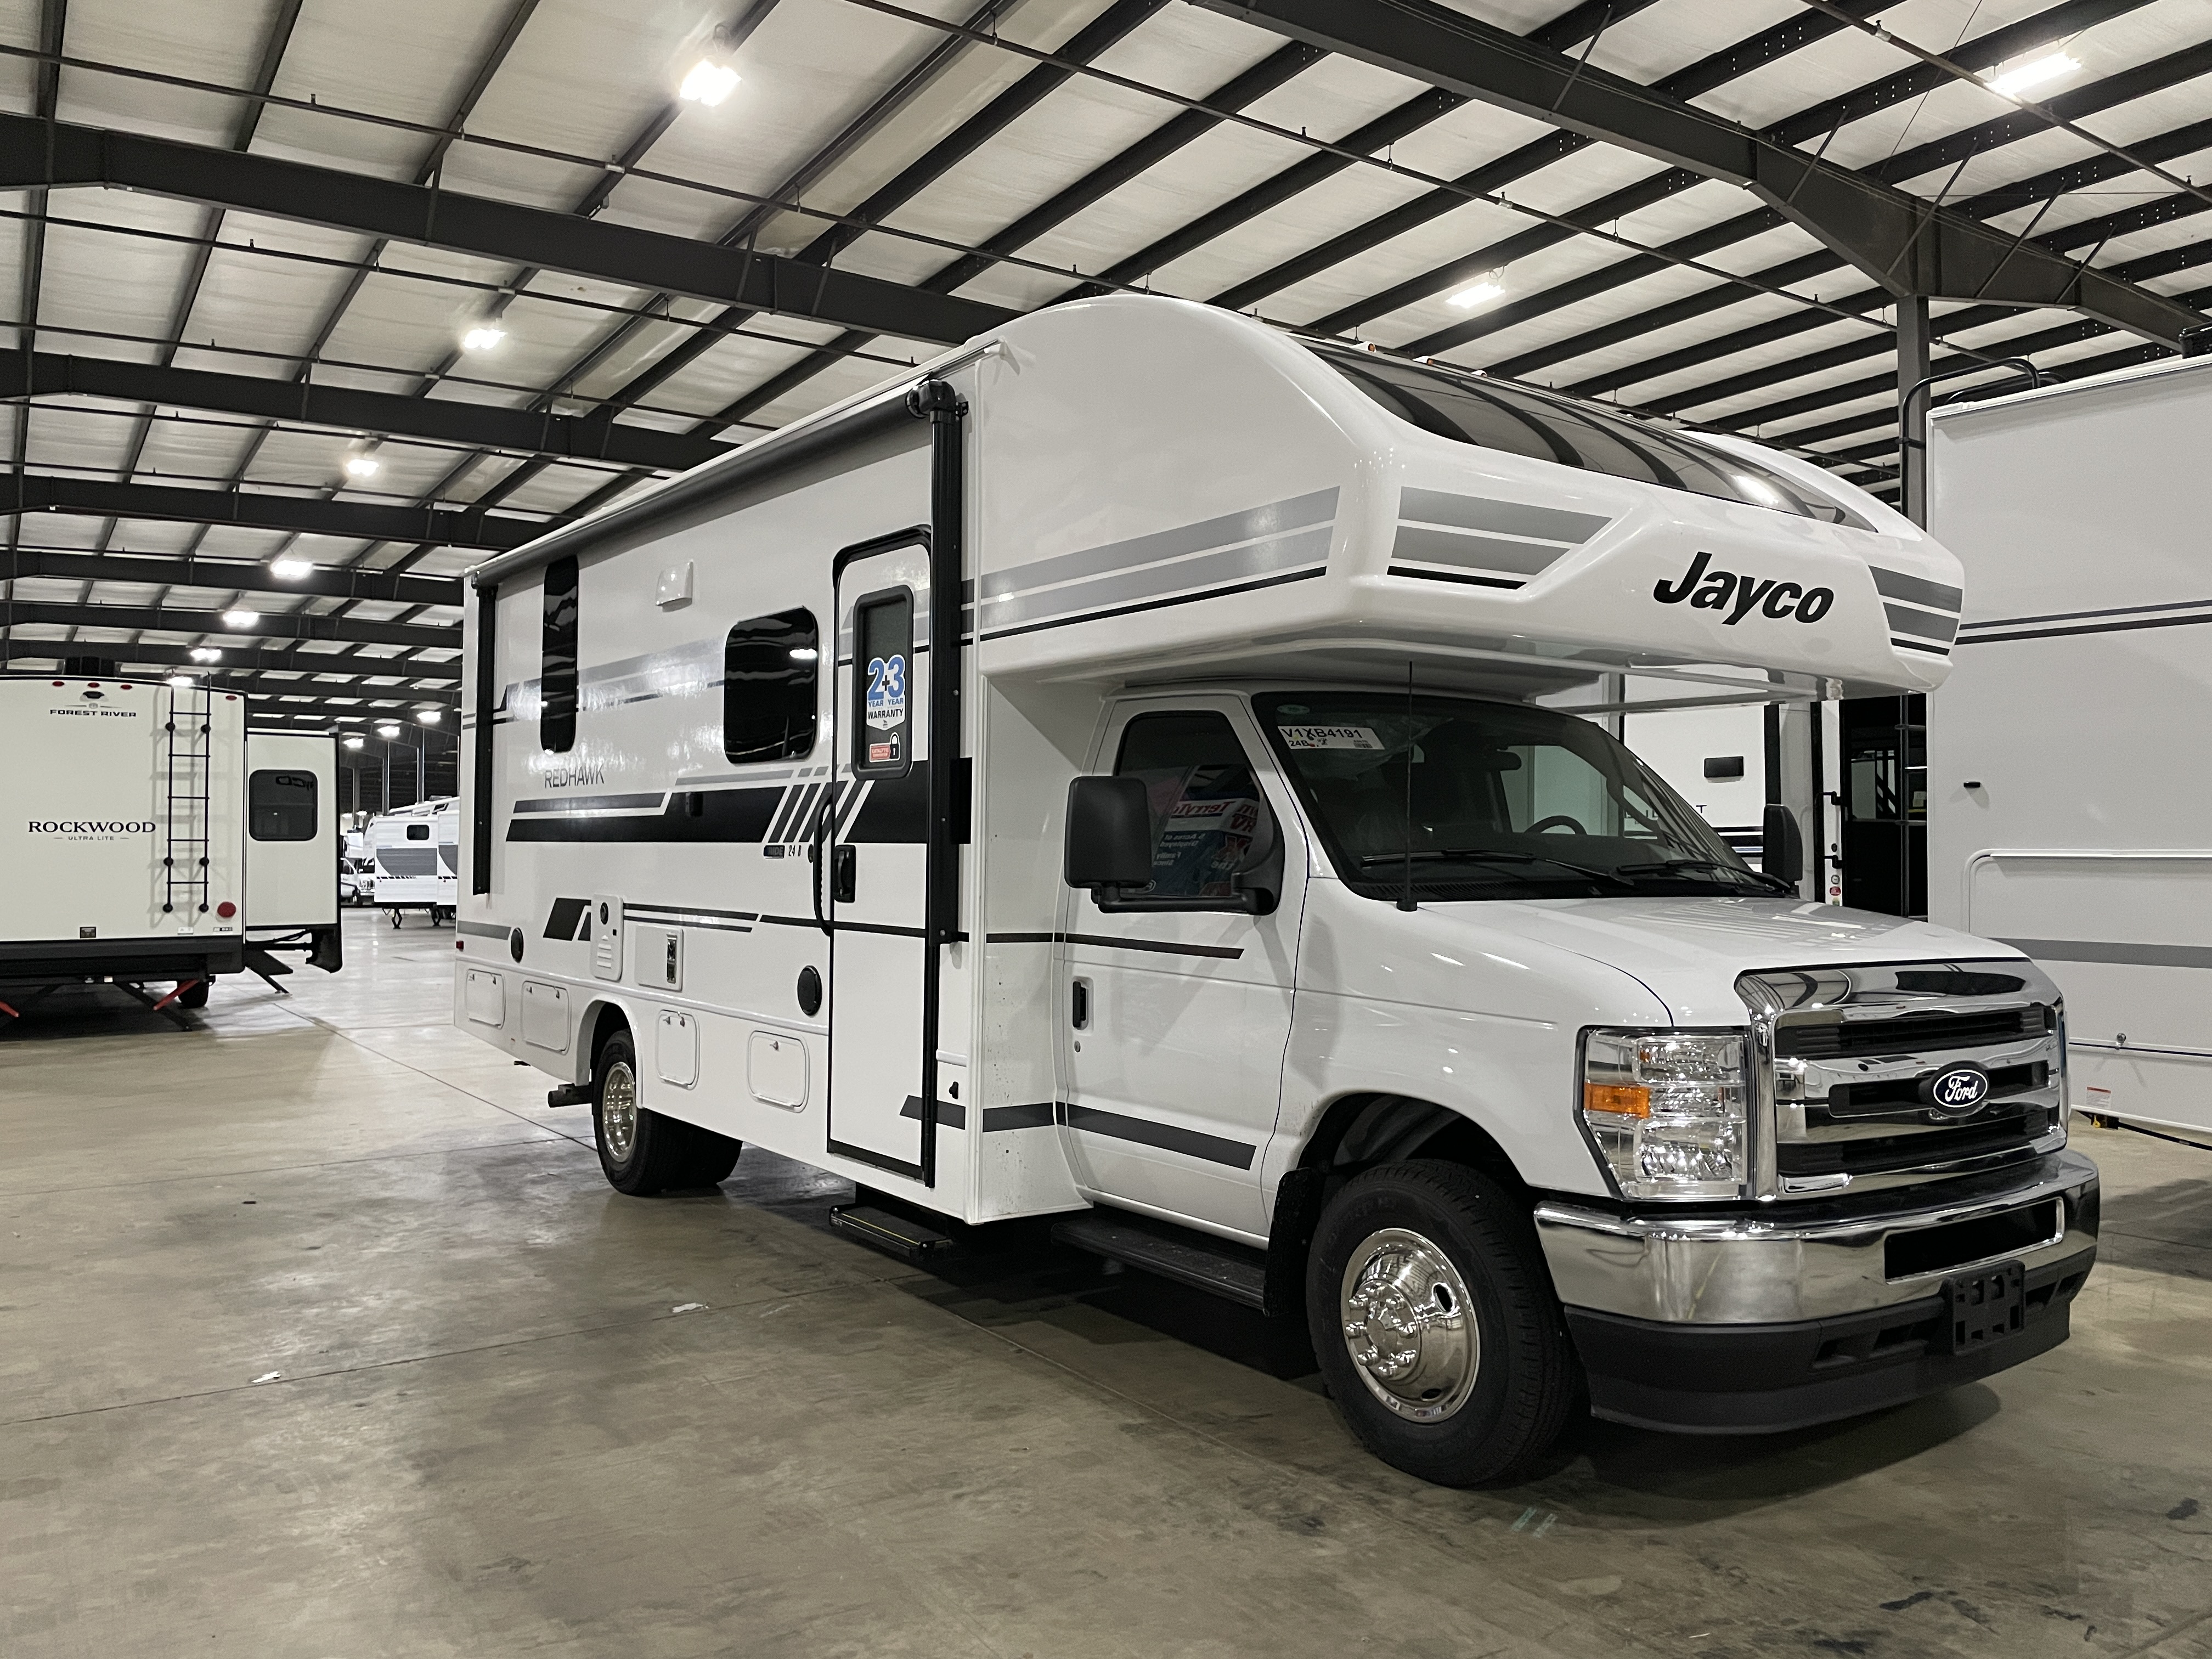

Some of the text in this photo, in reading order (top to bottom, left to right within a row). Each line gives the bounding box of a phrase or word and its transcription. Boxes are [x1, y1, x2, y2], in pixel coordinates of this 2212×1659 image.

[1653, 551, 1834, 625] Jayco
[868, 699, 884, 708] YEAR
[888, 697, 904, 706] YEAR
[868, 708, 904, 720] WARRANTY
[1281, 728, 1363, 738] V1XB4191
[545, 763, 605, 788] REDHAWK
[28, 821, 156, 833] ROCKWOOD
[1945, 1075, 1978, 1102] Ford
